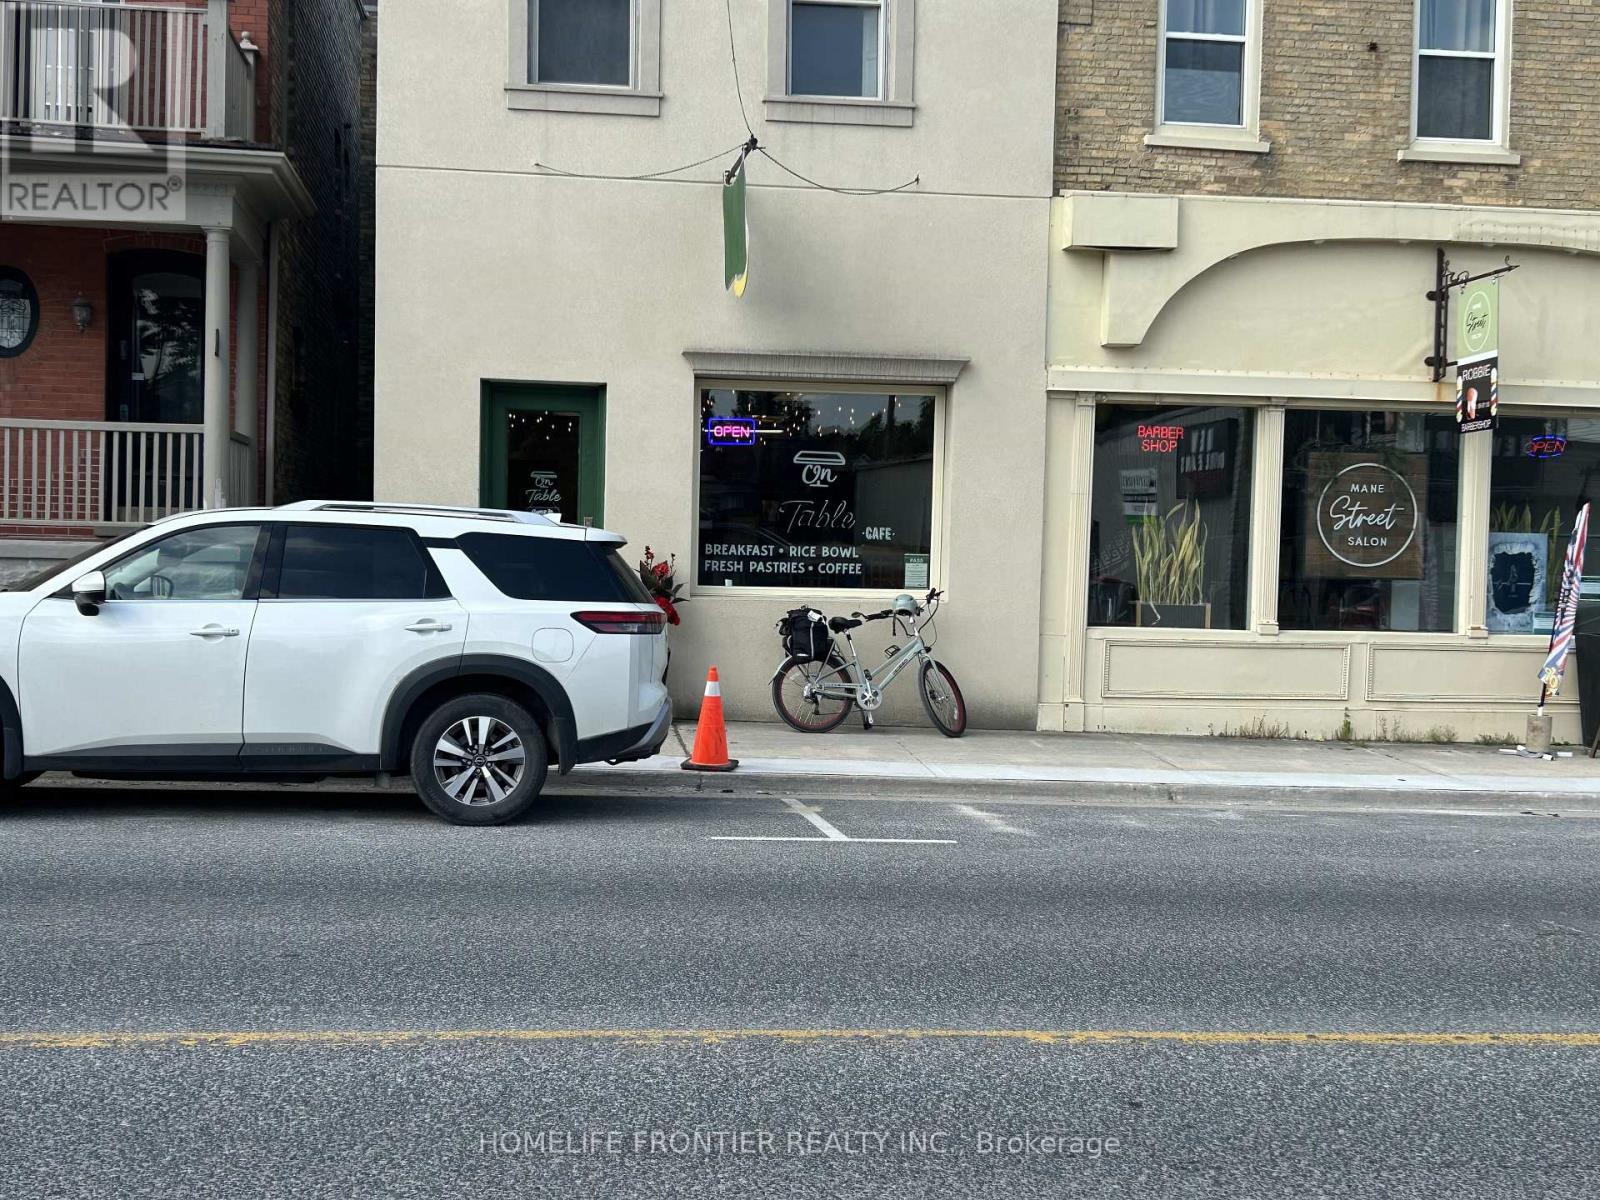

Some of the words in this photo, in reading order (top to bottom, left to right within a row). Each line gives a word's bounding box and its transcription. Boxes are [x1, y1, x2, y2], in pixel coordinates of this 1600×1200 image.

[1462, 364, 1491, 381] ROBBIE
[714, 425, 750, 438] OPEN
[1137, 425, 1184, 439] BARBER
[1141, 440, 1177, 452] SHOP
[525, 489, 562, 503] Table
[1350, 484, 1385, 494] MANE
[778, 500, 856, 534] Table
[1329, 495, 1405, 531] Street
[865, 526, 893, 541] CAFE
[1347, 536, 1387, 547] SALON
[705, 543, 775, 557] BREAKFAST
[789, 546, 817, 558] RICE
[822, 546, 860, 558] BOWL
[704, 560, 743, 572] FRESH
[749, 561, 806, 574] PASTRIES
[818, 562, 863, 574] COFFEE
